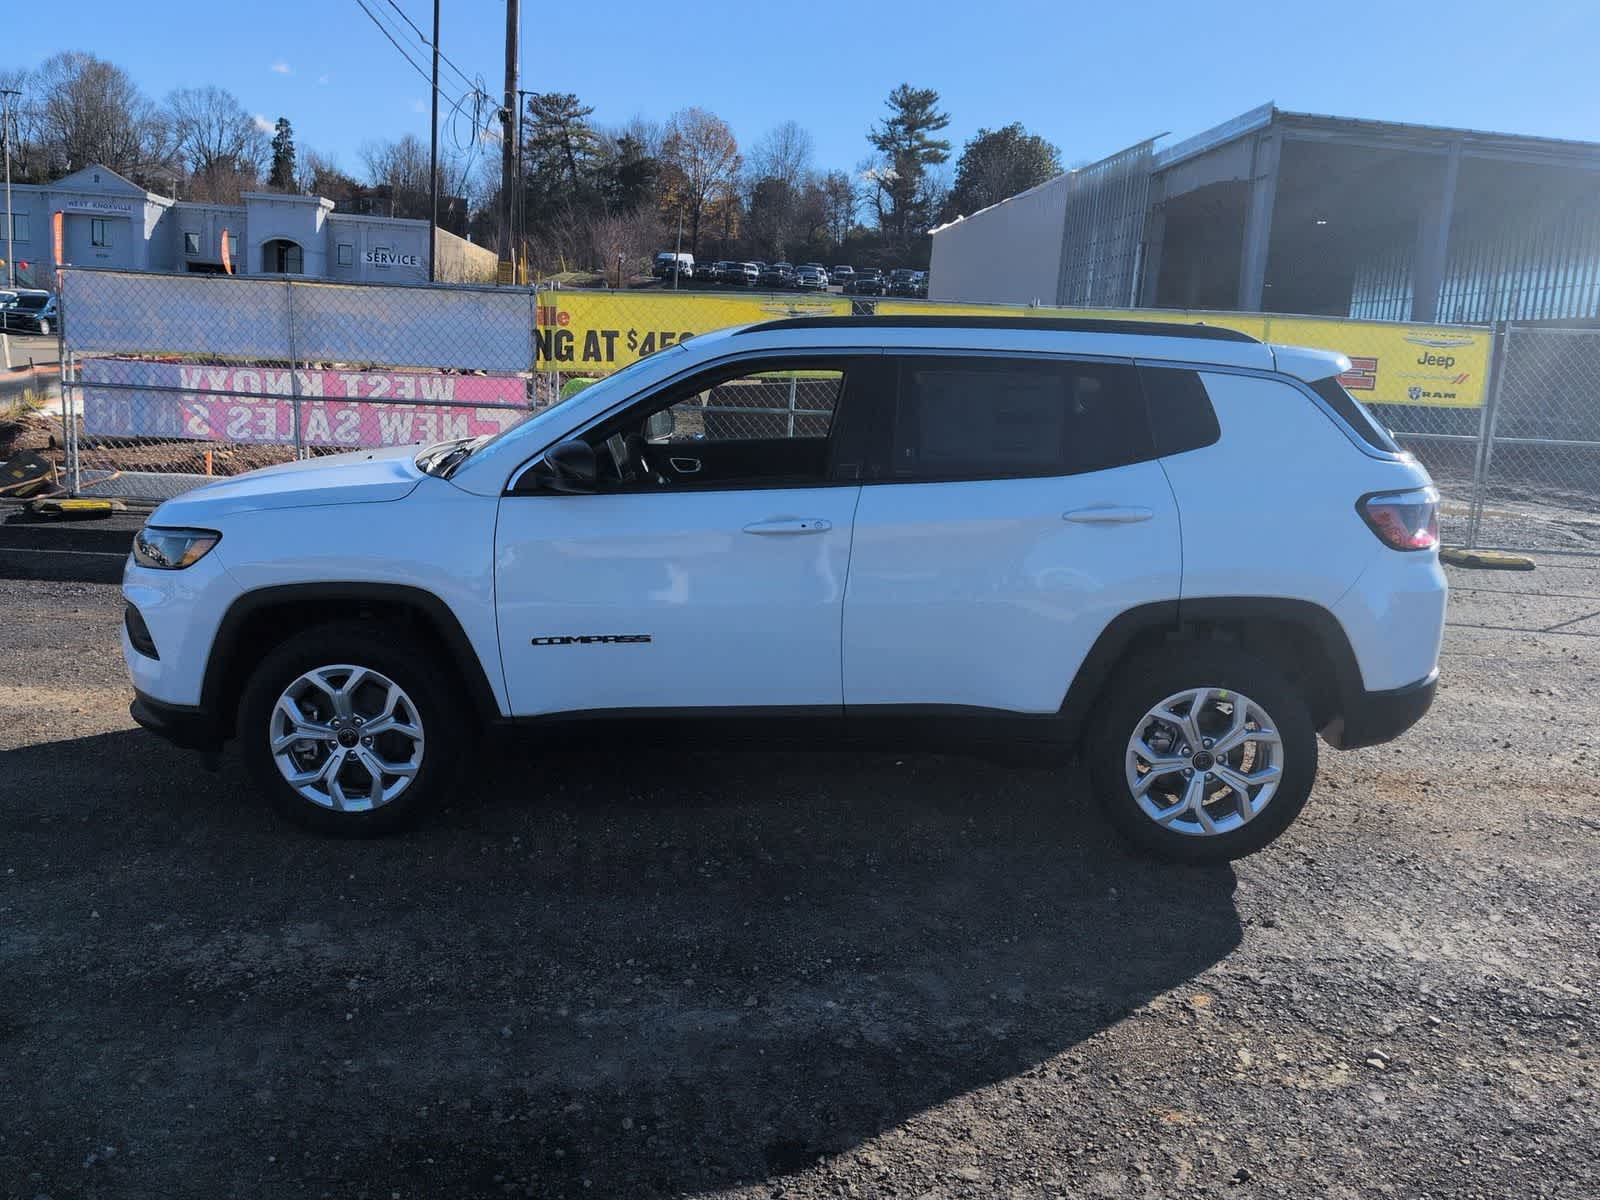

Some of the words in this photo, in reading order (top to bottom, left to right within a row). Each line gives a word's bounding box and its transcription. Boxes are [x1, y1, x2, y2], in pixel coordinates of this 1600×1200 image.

[68, 200, 88, 208] WEST
[93, 201, 132, 211] KNOXVILLE
[366, 252, 417, 265] SERVICE
[582, 330, 620, 362] AT
[1417, 352, 1456, 369] Jeep
[1421, 391, 1456, 399] RAM
[531, 635, 651, 646] COMPASS
